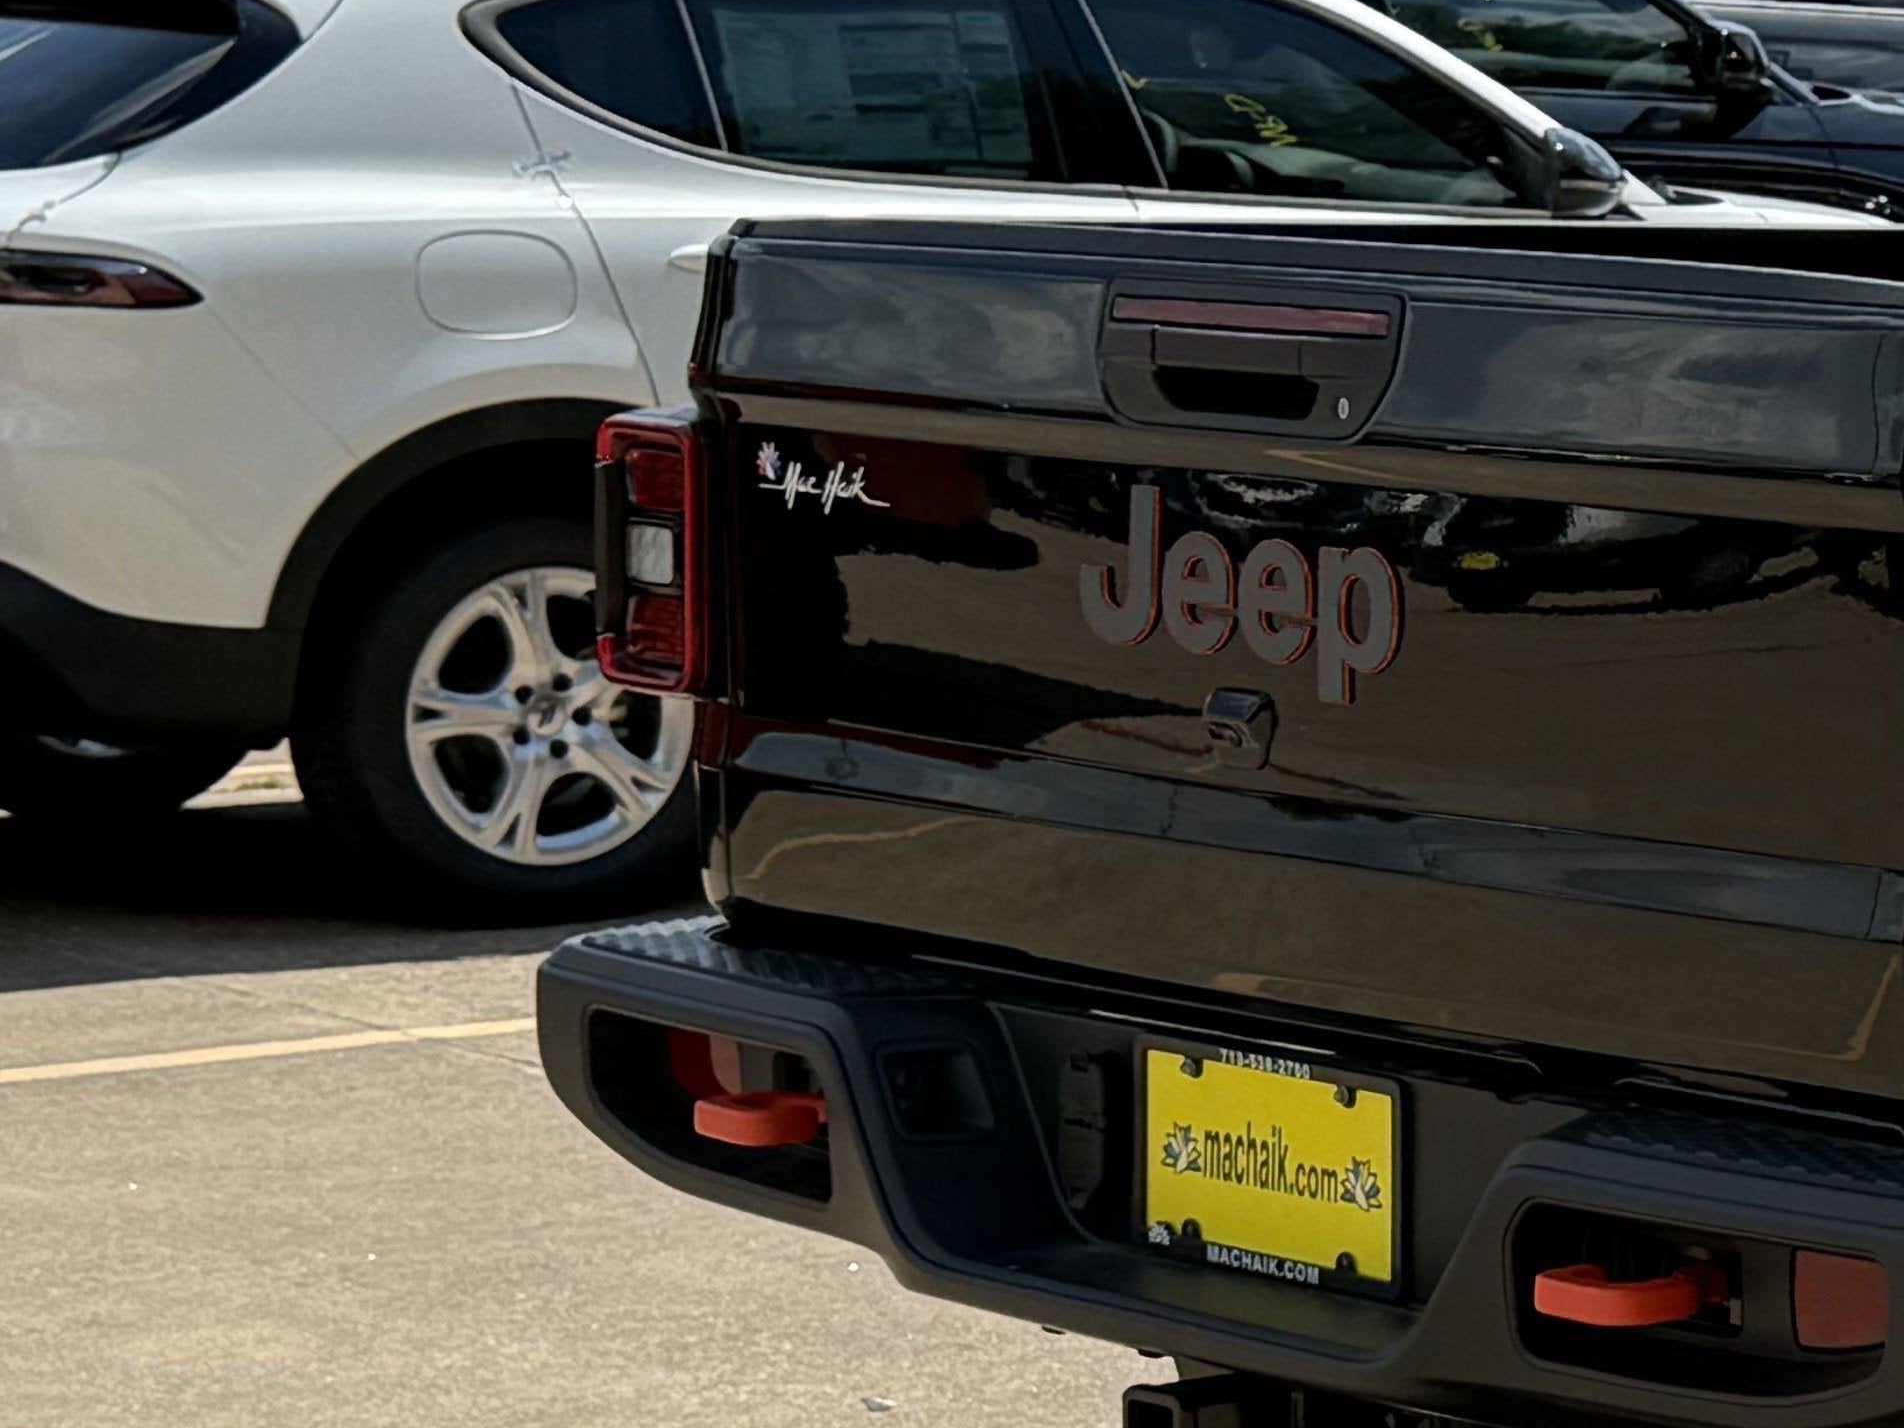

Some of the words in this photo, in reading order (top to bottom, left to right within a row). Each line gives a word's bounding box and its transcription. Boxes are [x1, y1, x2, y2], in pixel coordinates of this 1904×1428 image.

[1080, 484, 1405, 705] Jeep
[1202, 1121, 1339, 1204] machaik.com
[1206, 1244, 1320, 1285] MACHAIK.COM
